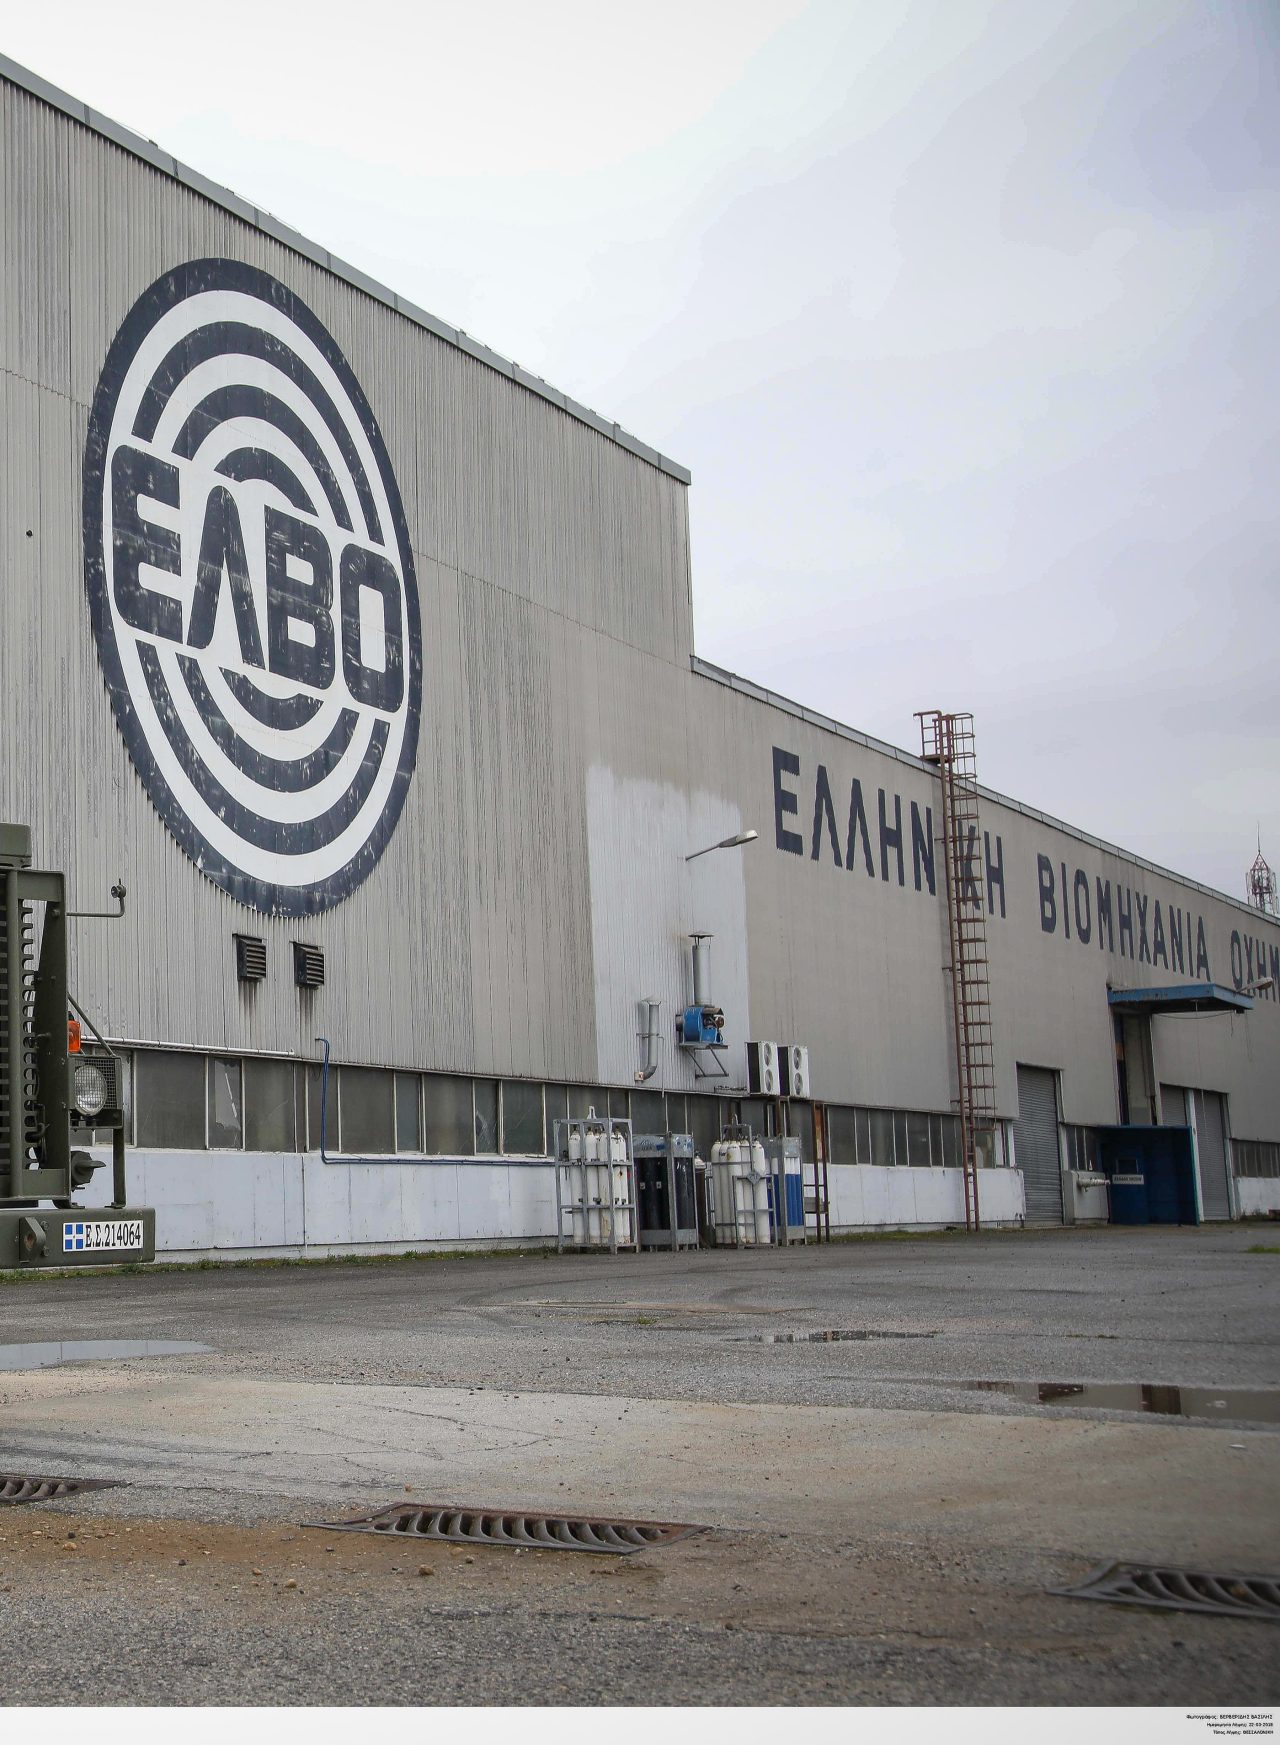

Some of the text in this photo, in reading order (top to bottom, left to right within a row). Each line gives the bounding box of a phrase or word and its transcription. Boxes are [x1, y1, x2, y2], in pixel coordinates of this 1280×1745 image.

[111, 444, 405, 713] ΕΛΒΟ
[772, 745, 1007, 919] ΕΛΛΗΝΚΗ
[1037, 852, 1211, 982] ΒΙΟΜΗΧΑΝΙΑ
[85, 1223, 141, 1248] Ε.Σ.214064
